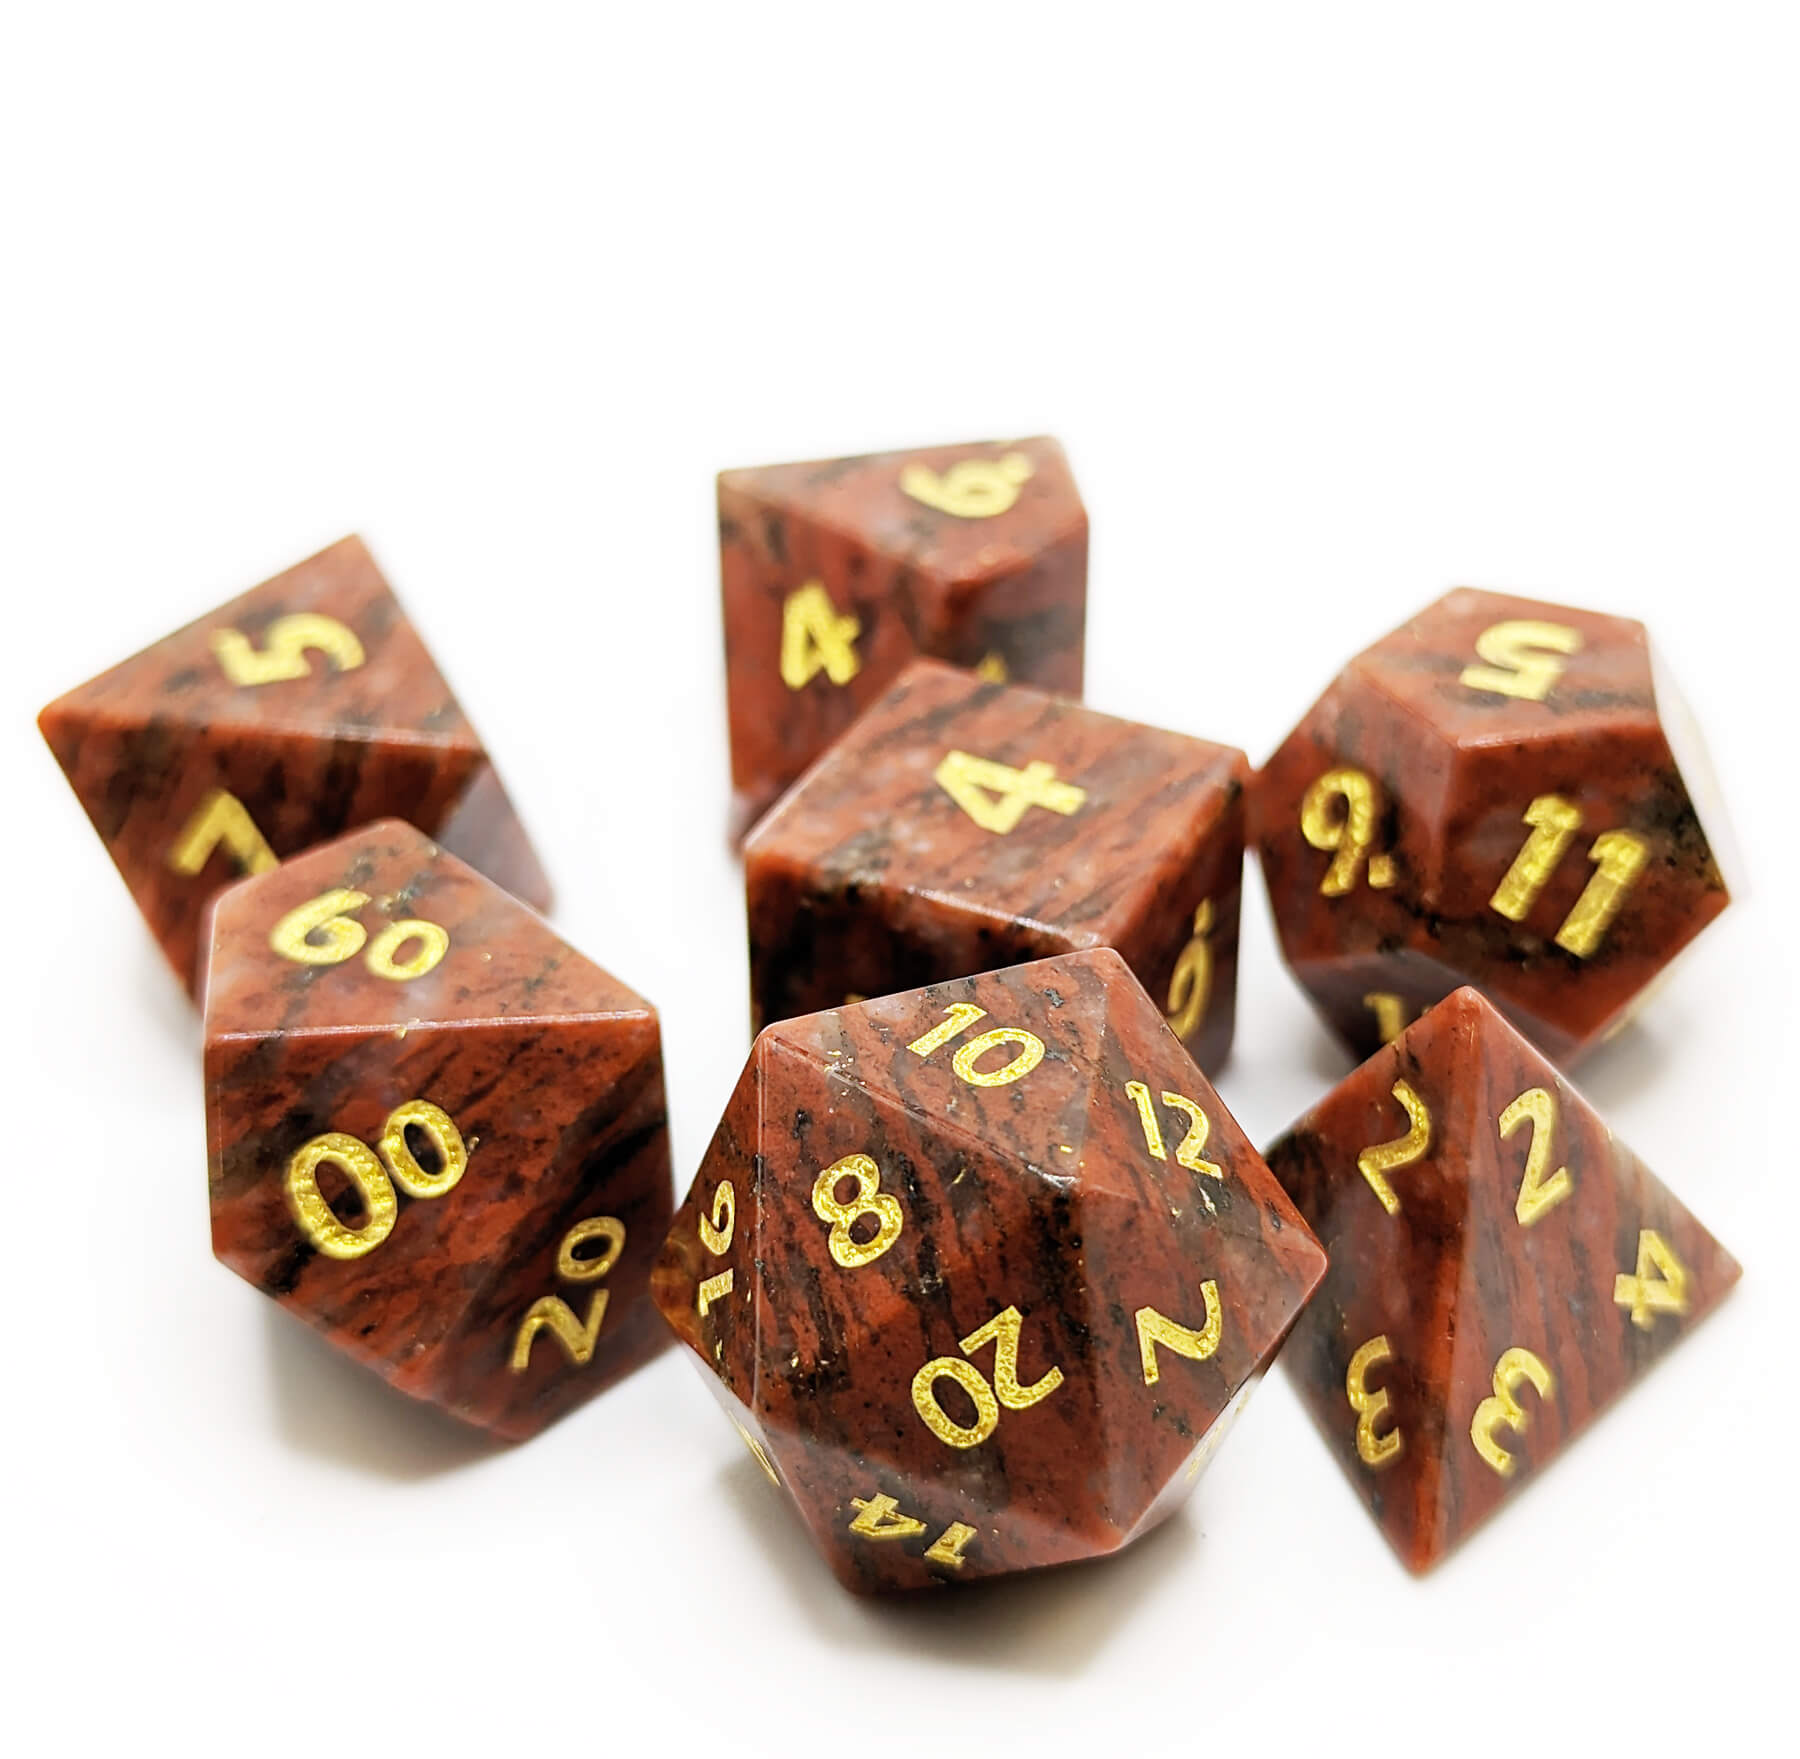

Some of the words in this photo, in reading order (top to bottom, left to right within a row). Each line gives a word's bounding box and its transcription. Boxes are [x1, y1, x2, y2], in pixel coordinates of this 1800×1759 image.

[210, 611, 366, 687] 5
[779, 582, 862, 690] 4
[1459, 618, 1583, 702] 5
[170, 788, 282, 877] 7
[934, 748, 1087, 835] 4
[1488, 793, 1653, 960] 11
[270, 887, 450, 982] 60
[907, 1001, 1047, 1088] 10
[286, 1099, 468, 1260] 00
[1125, 1079, 1223, 1181] 12
[1357, 1078, 1430, 1214] 2
[1498, 1087, 1573, 1225] 2
[698, 1179, 736, 1318] 16
[811, 1153, 905, 1270] 8
[1134, 1279, 1224, 1387] 2
[1613, 1229, 1688, 1330] 4
[910, 1304, 1065, 1450] 20
[1346, 1335, 1400, 1465] 3
[1470, 1347, 1554, 1475] 3
[850, 1493, 977, 1567] 14
